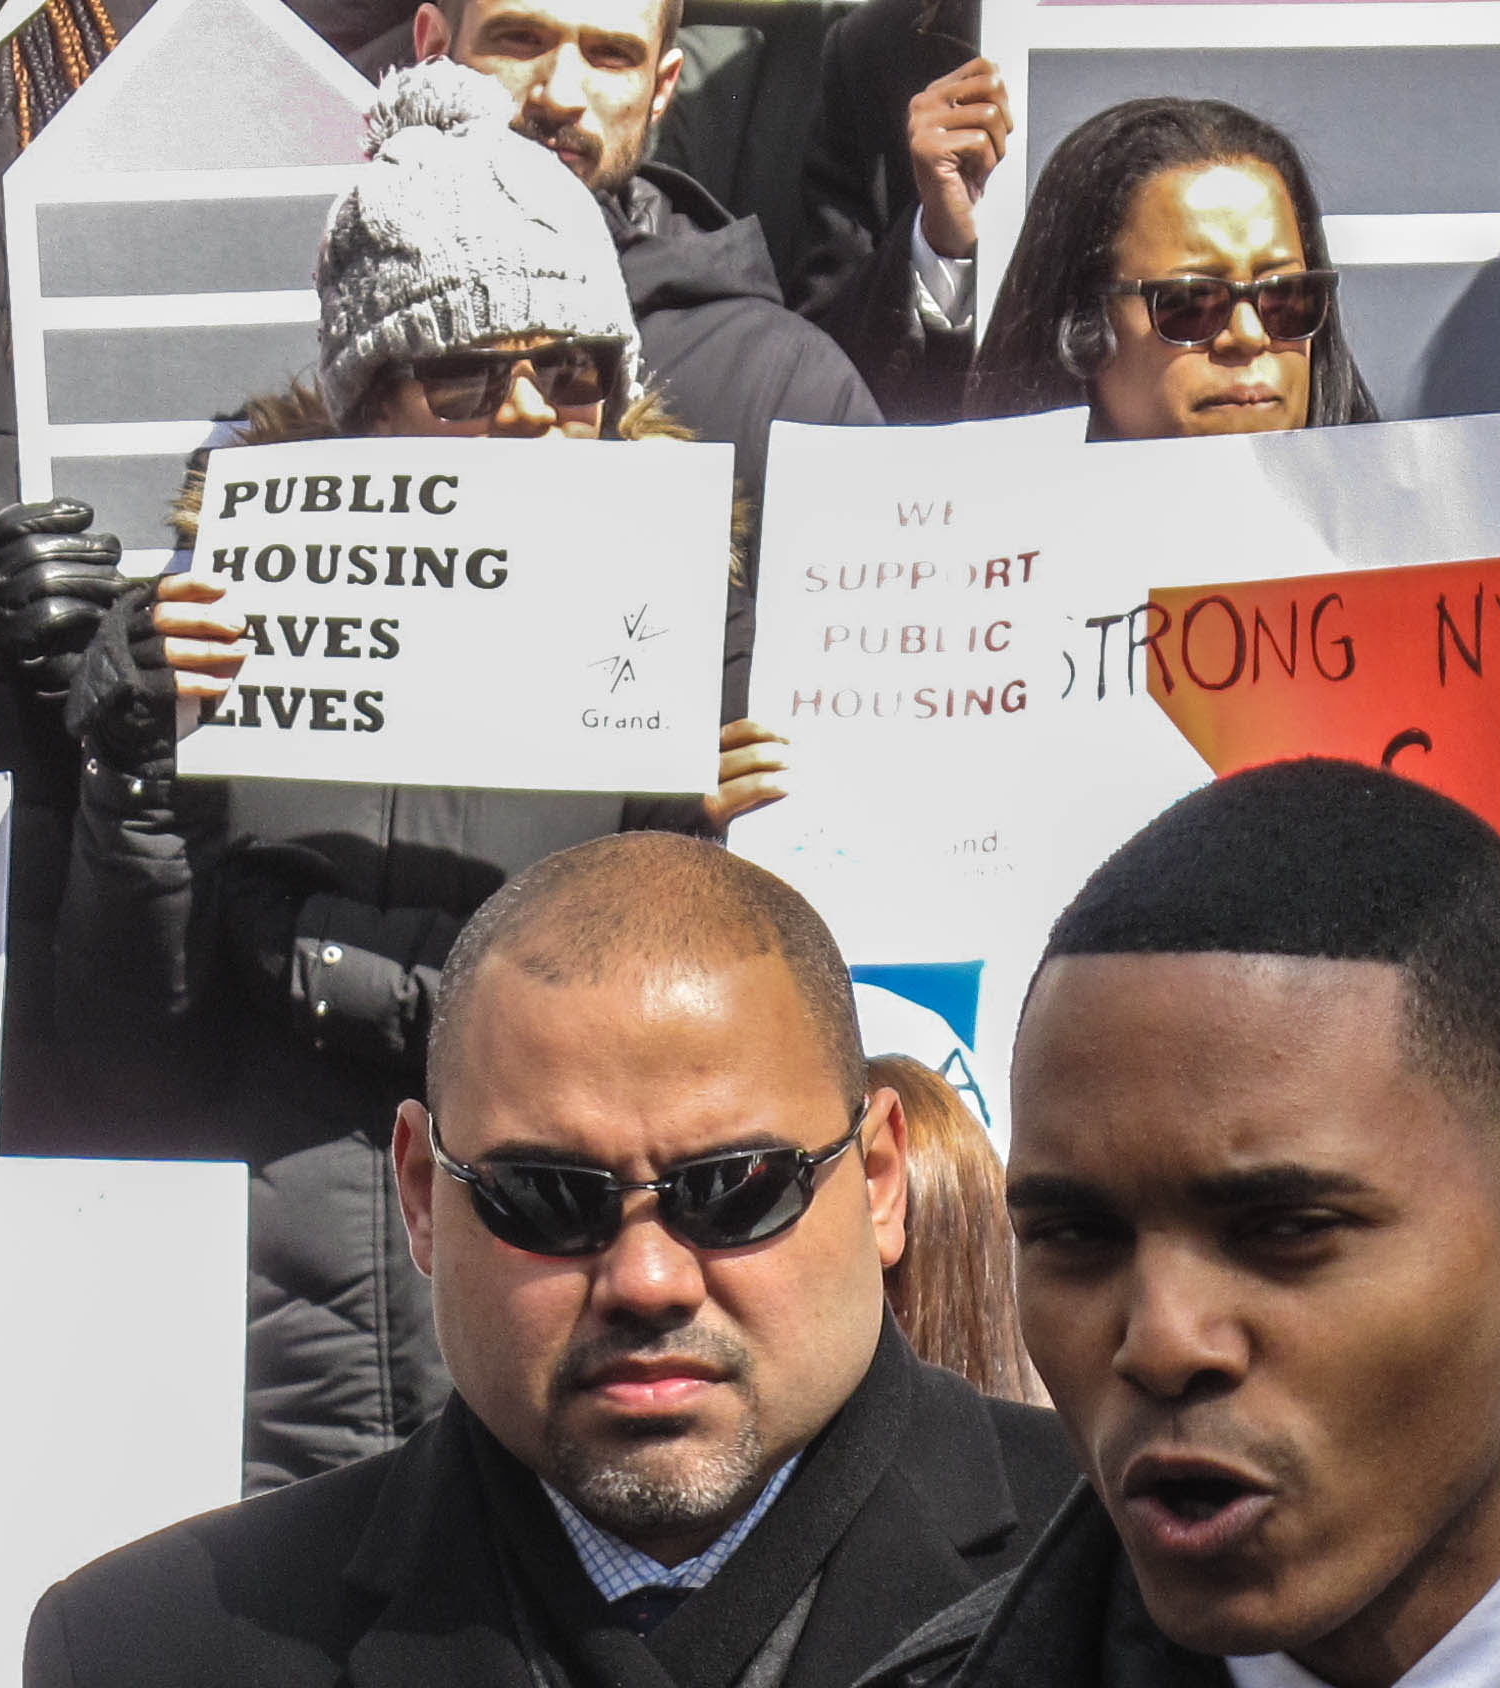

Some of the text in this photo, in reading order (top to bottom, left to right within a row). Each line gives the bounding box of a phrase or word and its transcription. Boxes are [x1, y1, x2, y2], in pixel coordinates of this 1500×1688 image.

[219, 473, 460, 519] PUBLIC
[211, 543, 510, 590] HOUSING
[241, 613, 401, 661] AVES
[823, 619, 1013, 655] PUBLIC
[791, 678, 1028, 720] HOUSING
